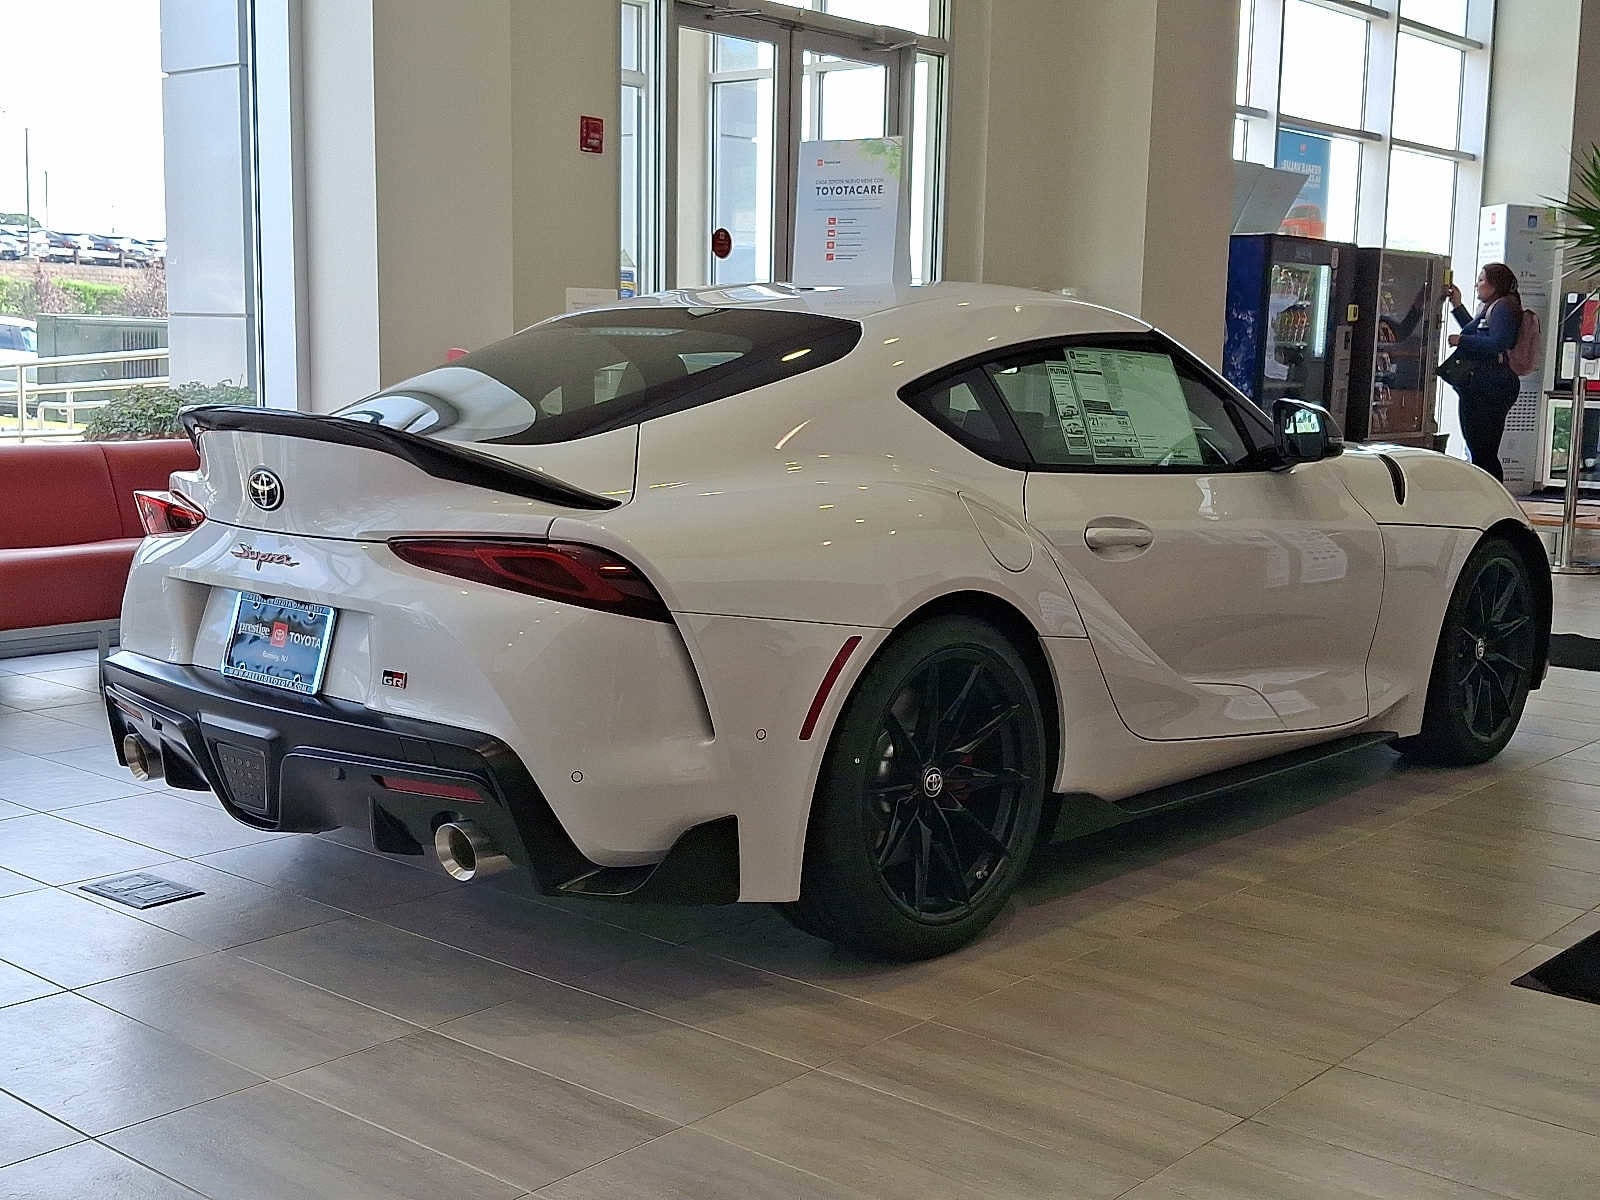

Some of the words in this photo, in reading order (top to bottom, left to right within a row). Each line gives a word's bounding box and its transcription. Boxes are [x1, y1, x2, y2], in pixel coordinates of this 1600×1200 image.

[816, 185, 884, 196] TOYOTACARE
[231, 542, 300, 571] Supra
[237, 622, 271, 638] prestige
[289, 631, 321, 648] TOYOTA
[383, 676, 403, 689] GR
